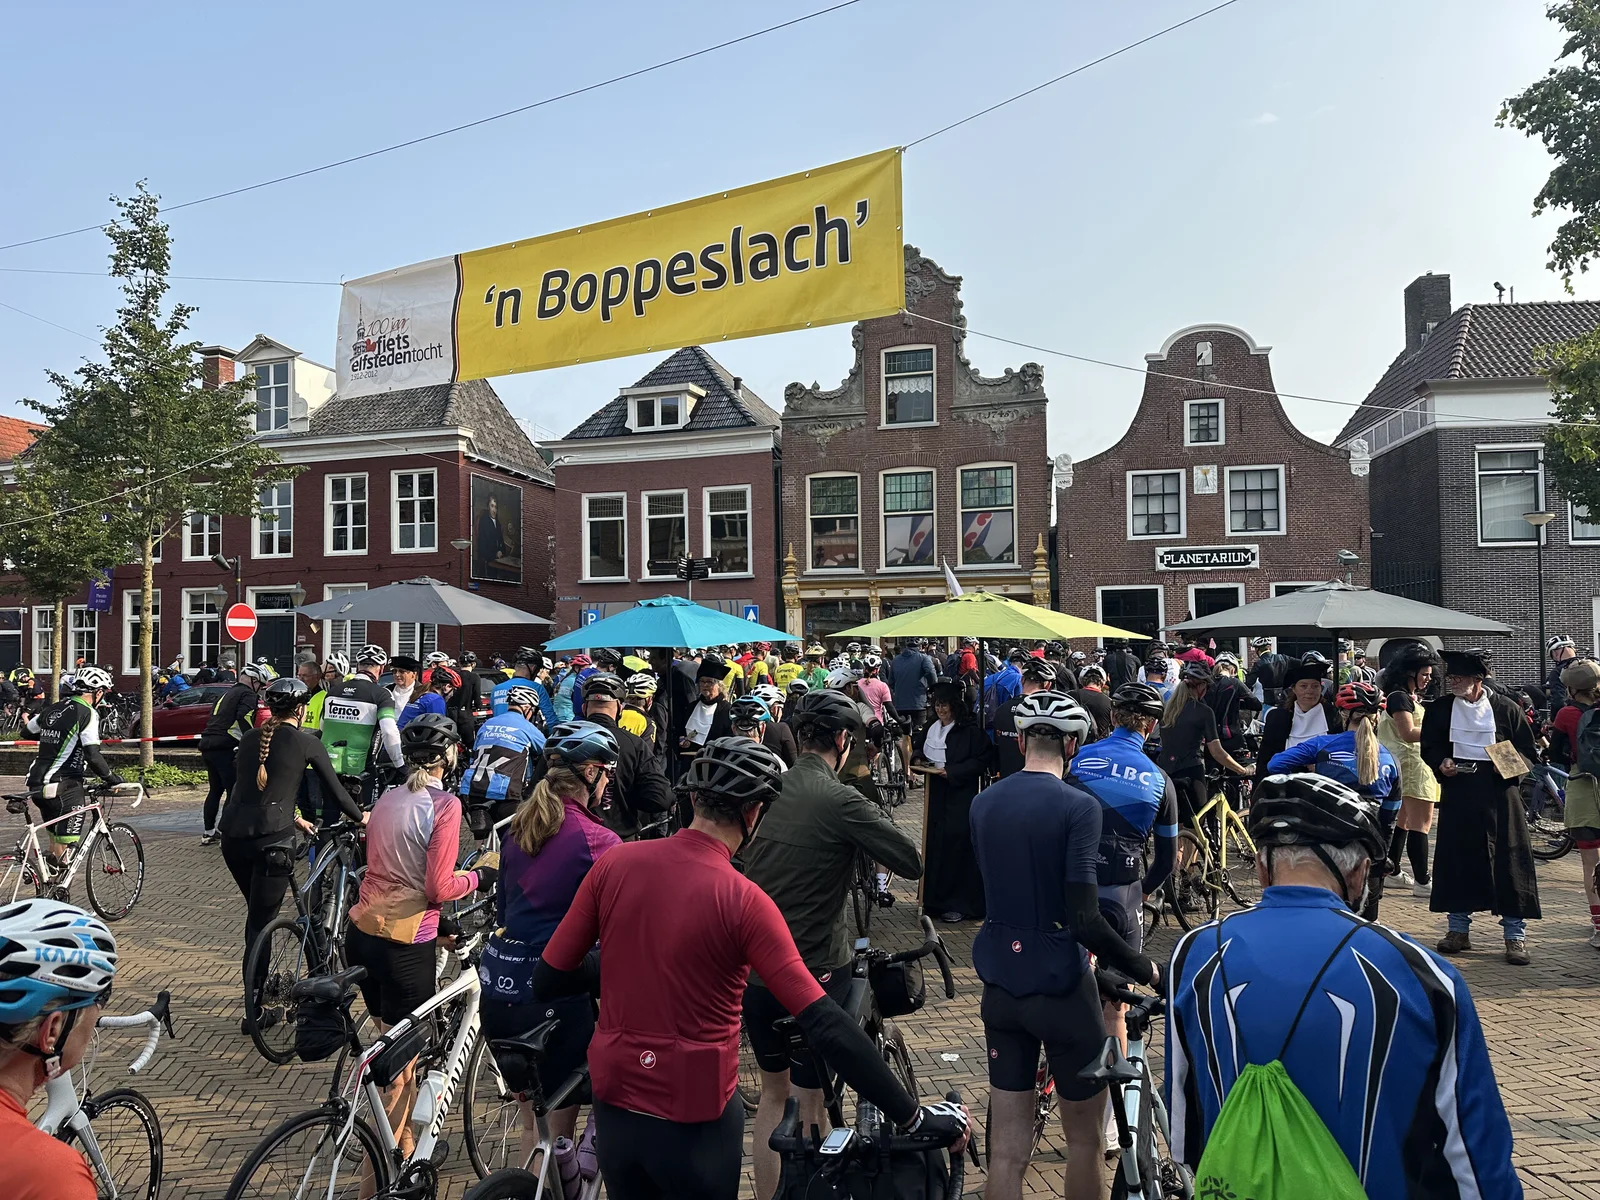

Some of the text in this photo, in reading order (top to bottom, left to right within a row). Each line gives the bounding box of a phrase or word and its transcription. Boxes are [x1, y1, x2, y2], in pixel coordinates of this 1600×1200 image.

[537, 200, 869, 322] Boppeslach'
[365, 318, 389, 337] 100
[376, 334, 410, 355] fiets
[351, 343, 443, 372] elfstedentocht
[351, 370, 378, 381] 1912-2012
[1163, 552, 1252, 564] PLANETARIUM
[588, 613, 596, 625] P
[328, 700, 360, 717] tenco
[484, 731, 517, 741] Kampioen
[1111, 763, 1152, 786] LBC
[35, 947, 91, 966] KASK
[431, 1025, 476, 1138] SPECIALIZED
